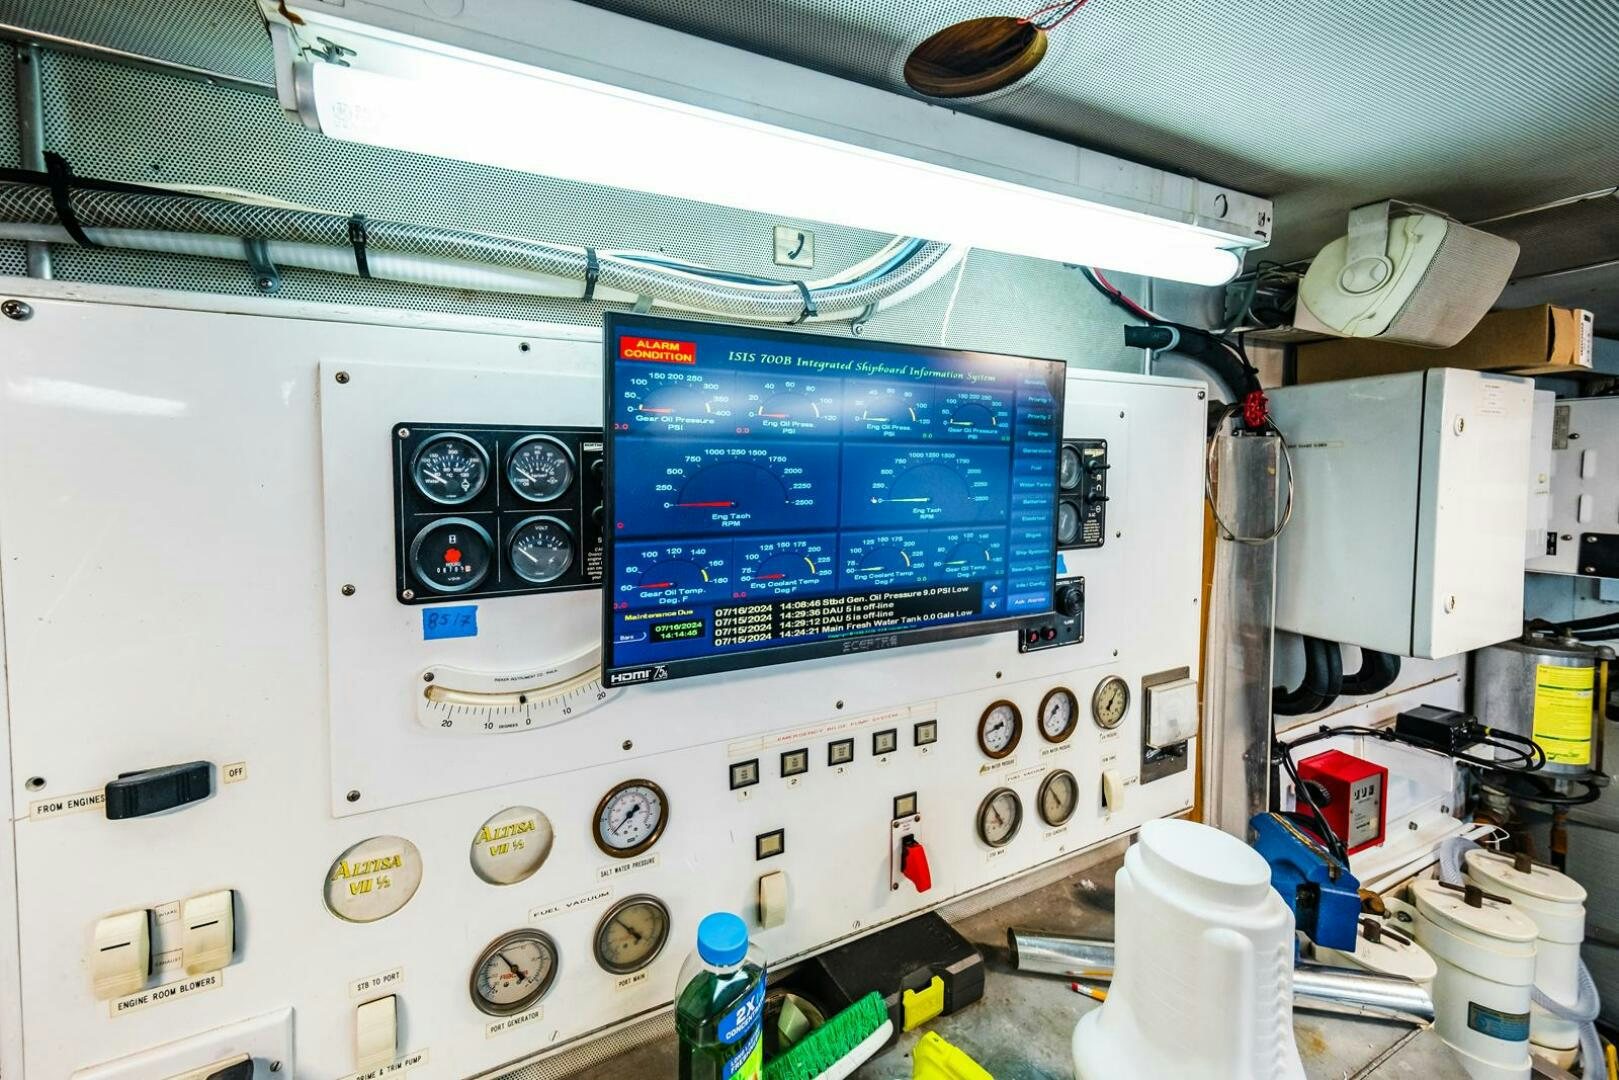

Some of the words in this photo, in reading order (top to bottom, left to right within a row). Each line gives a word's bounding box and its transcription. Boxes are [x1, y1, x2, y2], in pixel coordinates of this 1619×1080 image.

[636, 340, 680, 351] ALARM
[624, 350, 692, 362] CONDITION
[728, 351, 756, 362] ISIS
[760, 353, 792, 366] 700B
[797, 357, 854, 372] Integrated
[855, 361, 908, 376] Shipboard
[910, 366, 964, 380] Information
[966, 372, 996, 384] System
[676, 416, 715, 424] Pressure
[730, 512, 750, 520] Tach
[768, 580, 798, 588] Coolant
[659, 596, 680, 604] Deg.
[715, 604, 773, 618] 07/16/2024
[779, 600, 821, 610] 14:08:46
[822, 597, 845, 606] Stbd
[846, 596, 868, 604] Gen.
[870, 594, 882, 602] Oil
[884, 591, 922, 600] Pressure
[624, 611, 677, 621] Maintenance
[715, 614, 773, 628] 07/15/2024
[779, 609, 821, 620] 14:29:36
[822, 606, 844, 616] DAU
[846, 605, 852, 613] 5
[863, 602, 894, 611] off-line
[655, 622, 702, 632] 07/16/2024
[715, 623, 773, 637] 07/15/2024
[779, 618, 821, 630] 14:29:12
[822, 615, 844, 624] DAU
[863, 610, 894, 620] off-line
[715, 632, 773, 647] 07/15/2024
[778, 627, 820, 639] 14:24:21
[822, 624, 844, 633] Main
[846, 620, 872, 630] Fresh
[874, 618, 900, 627] Water
[902, 615, 922, 624] Tank
[956, 609, 972, 617] Low
[596, 691, 606, 700] 20
[562, 706, 572, 715] 10
[441, 719, 452, 728] 20
[229, 768, 244, 778] OFF
[37, 802, 63, 814] FROM
[68, 794, 106, 809] ENGINES
[331, 854, 402, 881] ALTISA
[533, 906, 560, 918] FUEL
[566, 891, 609, 908] VACUUM
[357, 982, 369, 991] STB
[372, 978, 380, 986] TO
[383, 972, 400, 982] PORT
[618, 978, 632, 988] PORT
[118, 996, 148, 1011] ENGINE
[152, 986, 176, 1000] ROOM
[180, 976, 216, 993] BLOWERS
[736, 996, 755, 1026] 2X
[490, 1022, 506, 1033] PORT
[508, 1011, 539, 1027] GENERATOR
[386, 1063, 402, 1072] TRIM
[405, 1056, 422, 1066] PUMP
